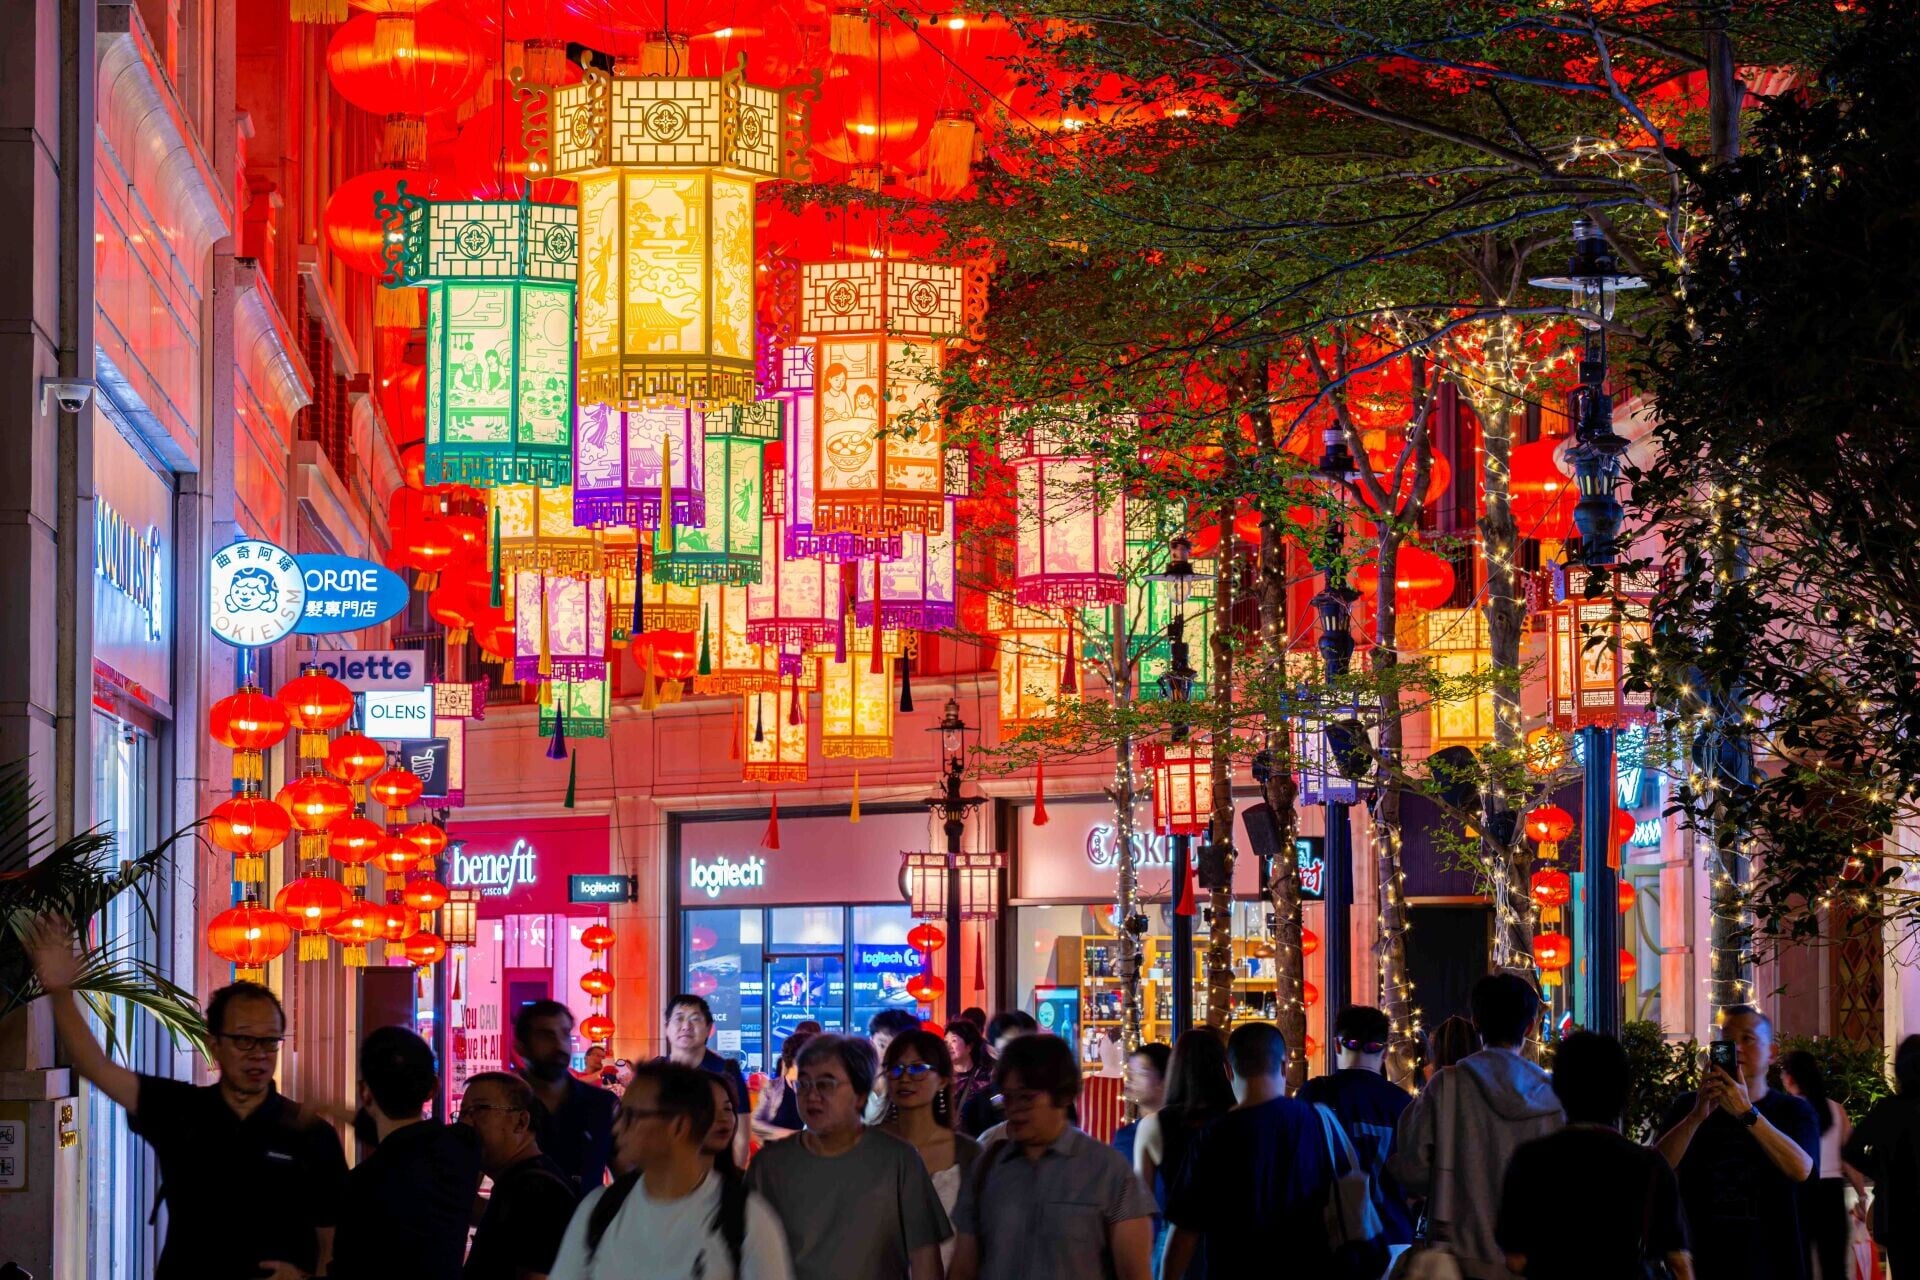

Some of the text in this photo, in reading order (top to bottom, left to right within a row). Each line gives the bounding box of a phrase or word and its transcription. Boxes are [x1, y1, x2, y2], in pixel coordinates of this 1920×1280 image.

[304, 570, 378, 592] ORME
[371, 705, 426, 719] OLENS
[452, 839, 537, 895] benefit
[690, 856, 765, 897] logitech
[580, 881, 620, 896] logitech
[862, 952, 902, 966] logitech
[460, 1004, 498, 1030] You CAN
